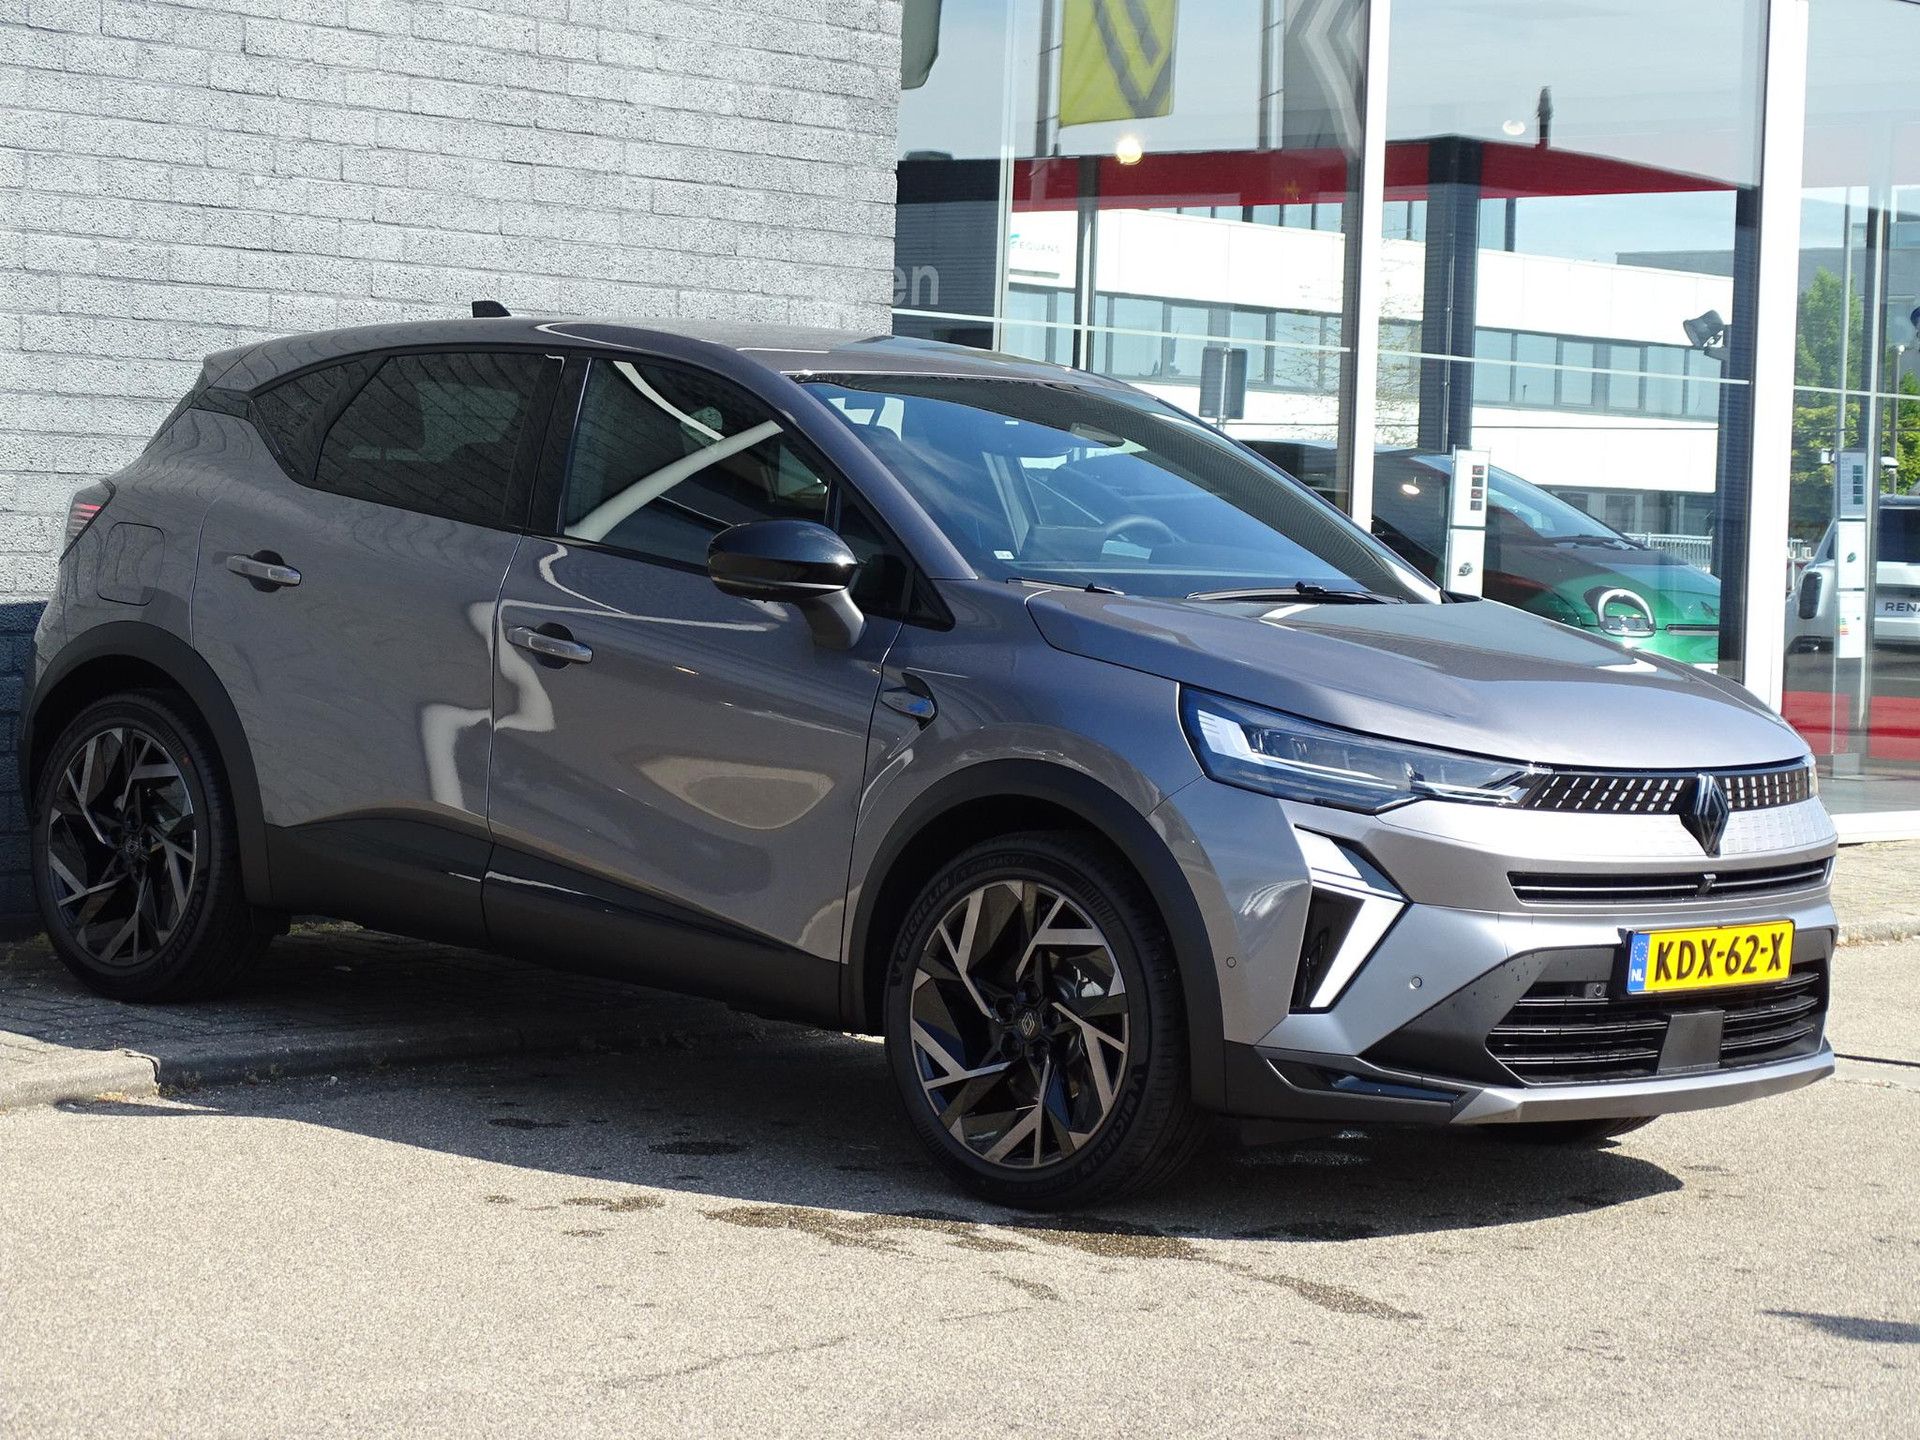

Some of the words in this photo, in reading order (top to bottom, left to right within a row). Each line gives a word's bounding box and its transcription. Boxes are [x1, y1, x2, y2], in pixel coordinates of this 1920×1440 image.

[1885, 602, 1920, 612] REN
[1654, 932, 1785, 982] KDX-62-X
[1631, 968, 1644, 982] NL
